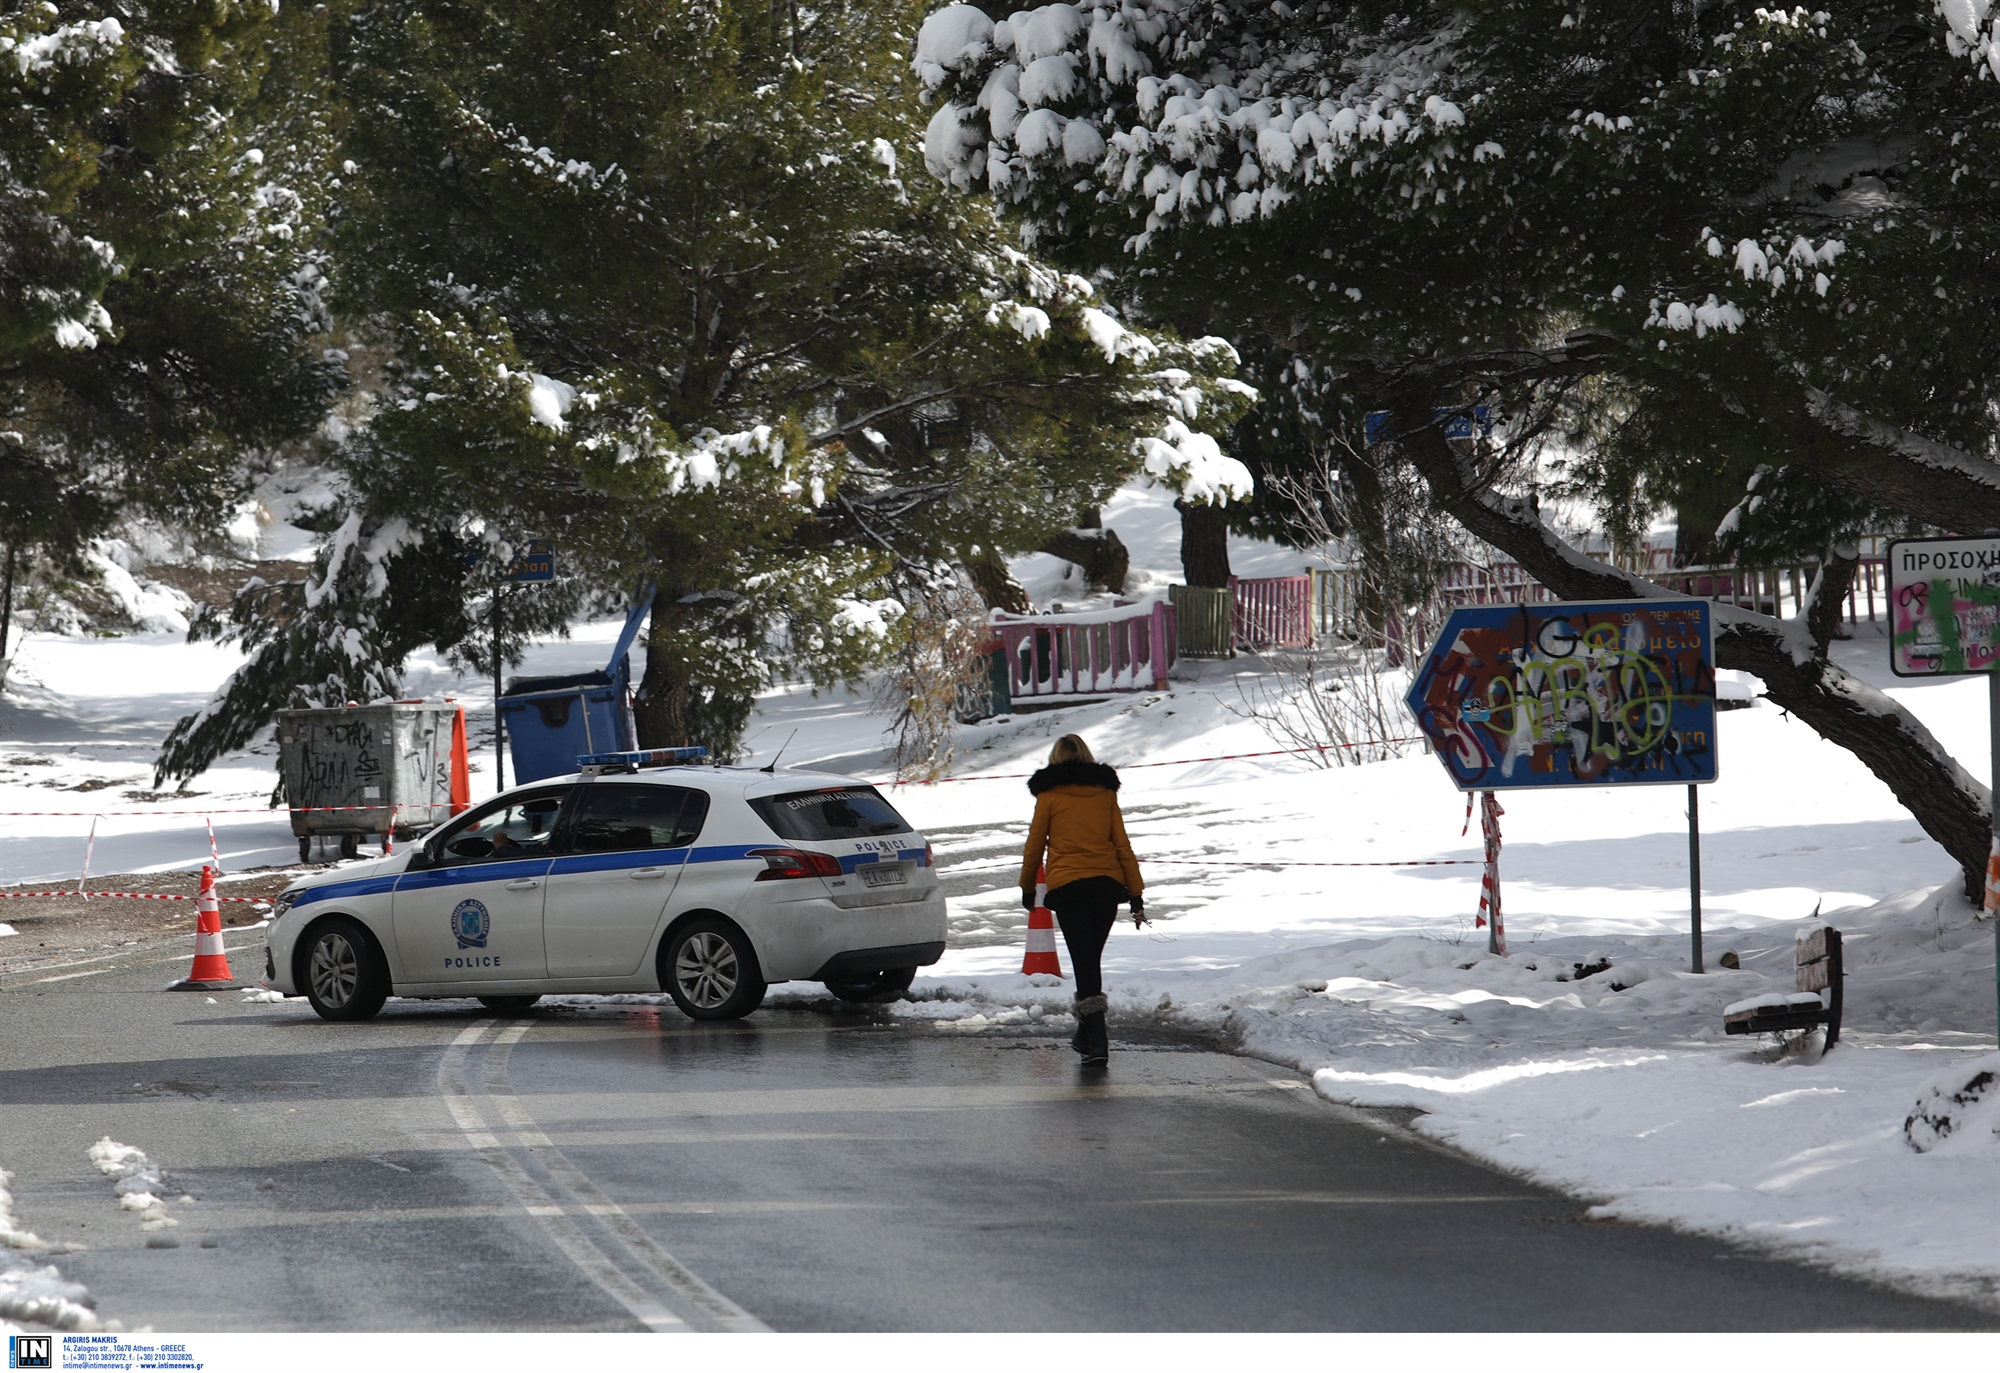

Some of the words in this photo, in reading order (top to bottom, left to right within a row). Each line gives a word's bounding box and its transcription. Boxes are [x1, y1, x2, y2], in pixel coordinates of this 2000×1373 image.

[787, 793, 834, 810] ΕΛΛΗΝΙΚΗ
[855, 840, 907, 853] POLICE
[444, 956, 501, 968] POLICE
